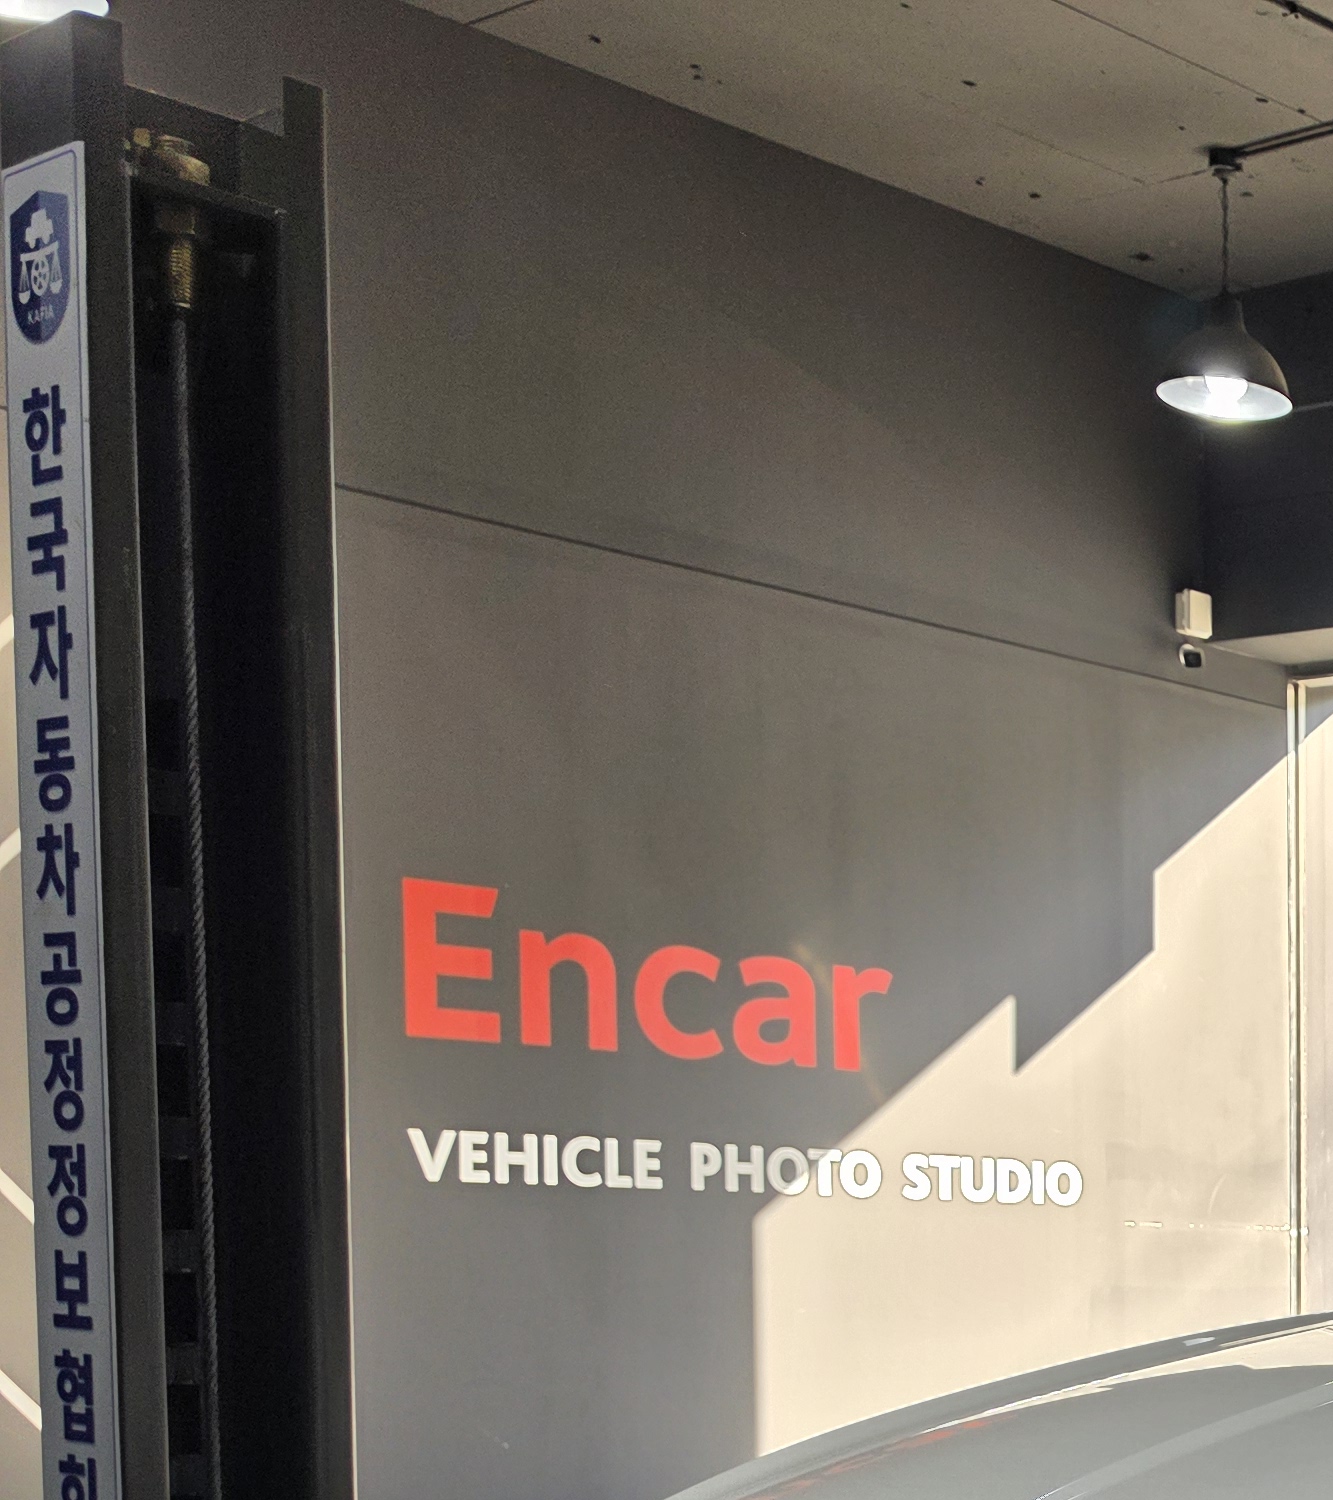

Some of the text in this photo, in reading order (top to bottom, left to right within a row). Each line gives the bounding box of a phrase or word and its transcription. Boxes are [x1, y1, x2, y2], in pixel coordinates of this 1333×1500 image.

[402, 876, 893, 1072] Encar
[406, 1127, 1084, 1208] VEHICLE PHOTO STUDIO
